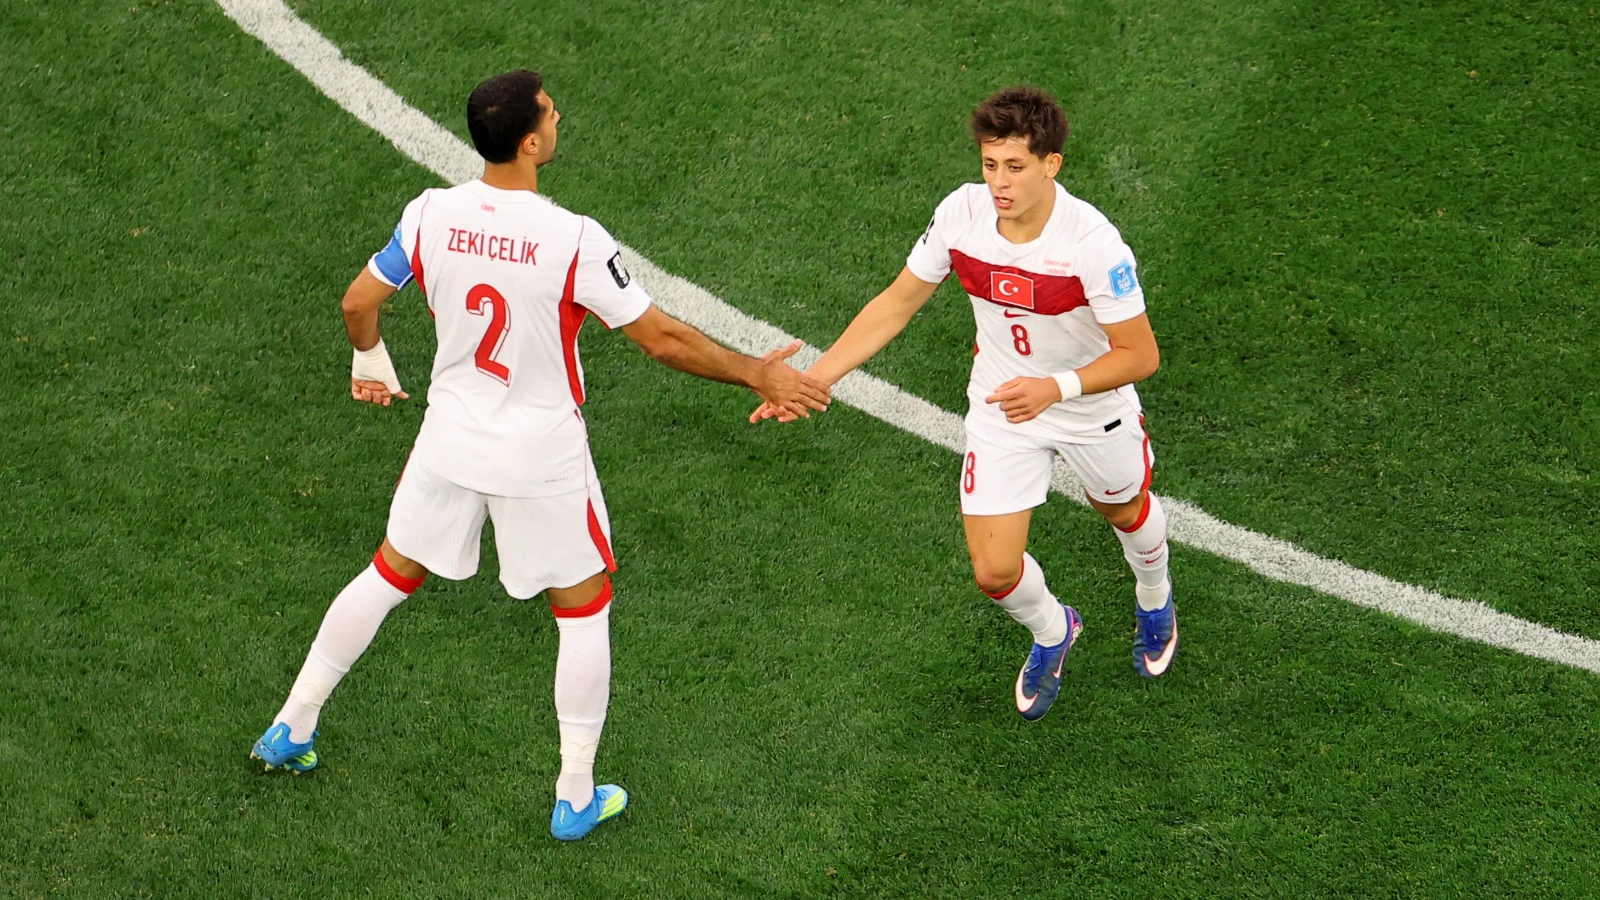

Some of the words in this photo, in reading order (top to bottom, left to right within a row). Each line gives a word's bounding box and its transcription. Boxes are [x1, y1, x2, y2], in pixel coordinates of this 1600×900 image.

[447, 228, 485, 256] ZEKİ
[488, 235, 540, 266] ÇELİK
[465, 283, 512, 388] 2
[1011, 324, 1033, 358] 8
[964, 451, 976, 496] 8
